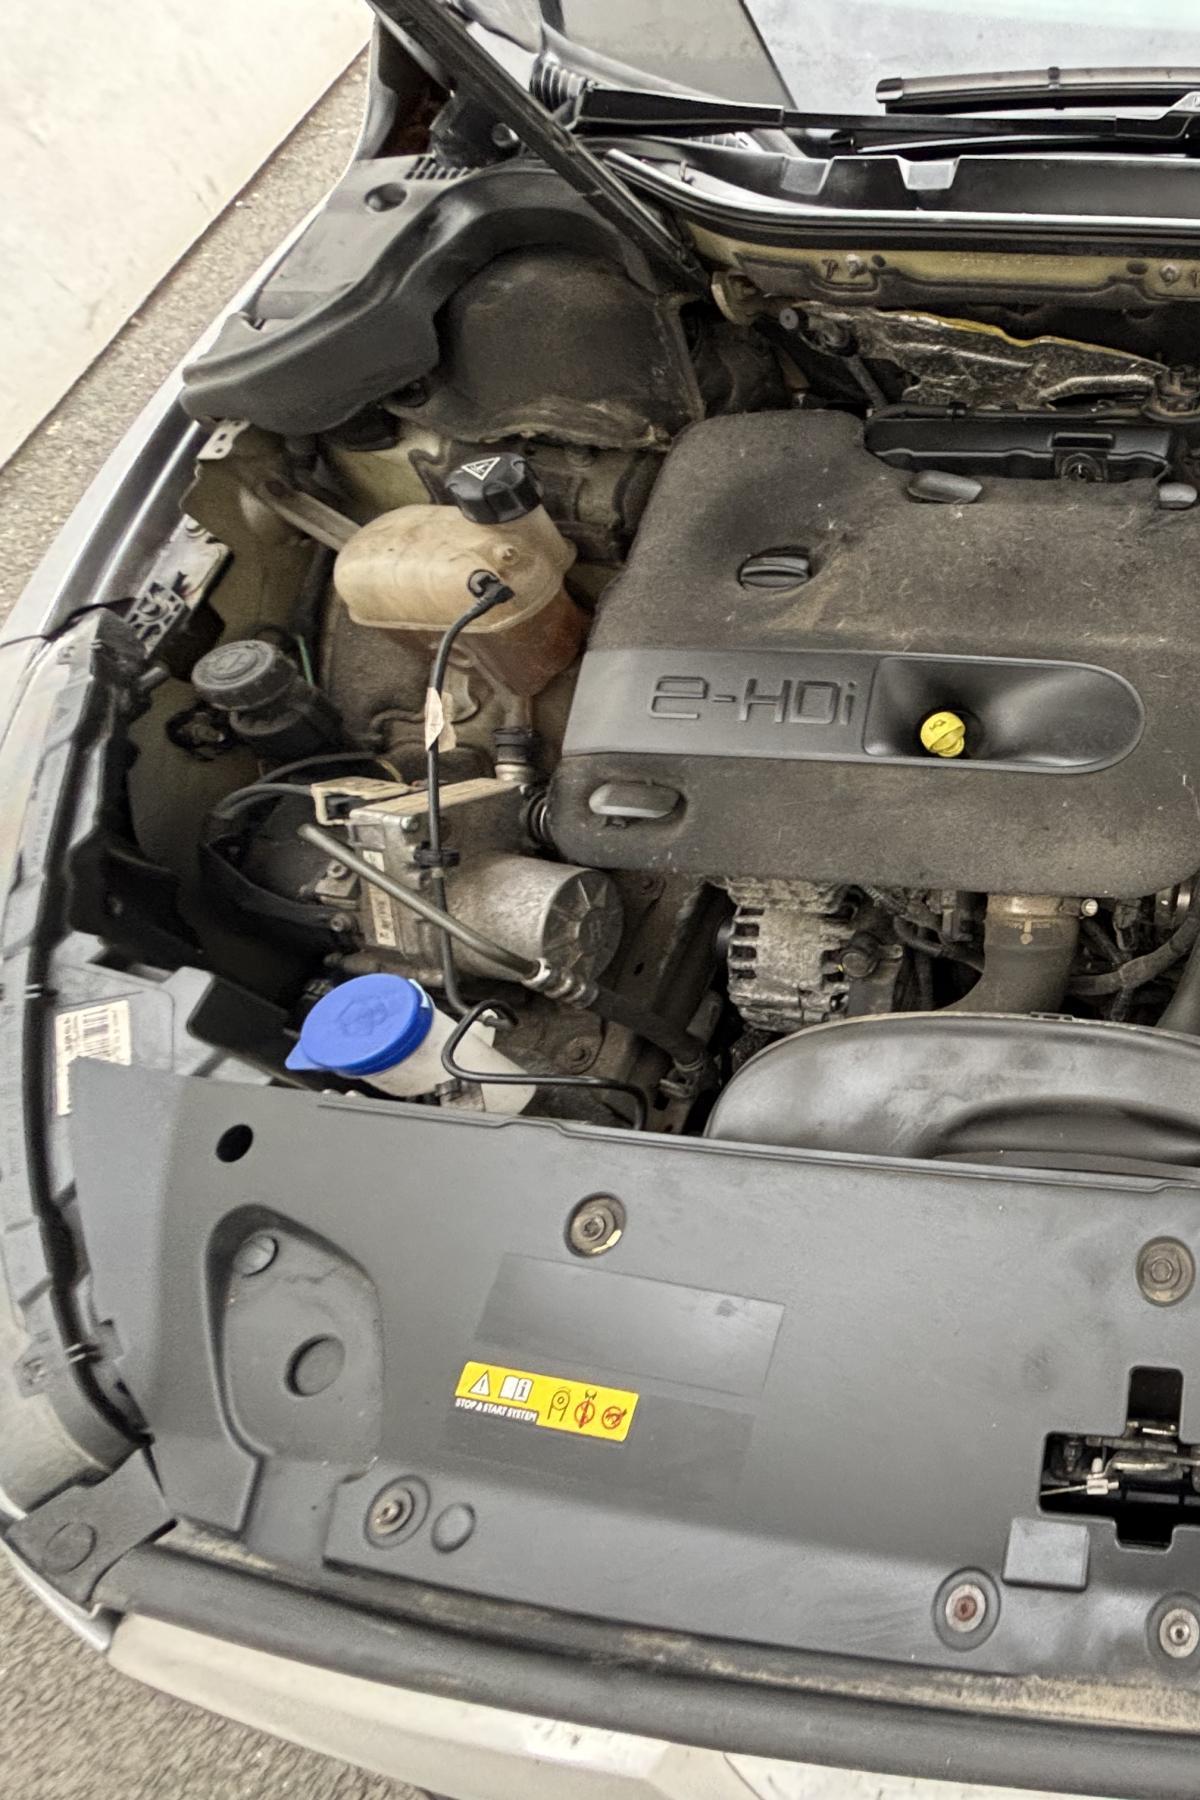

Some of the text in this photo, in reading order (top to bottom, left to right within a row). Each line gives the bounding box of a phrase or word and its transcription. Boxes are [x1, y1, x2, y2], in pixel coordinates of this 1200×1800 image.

[455, 1398, 538, 1422] STOP & START SYSTEM
